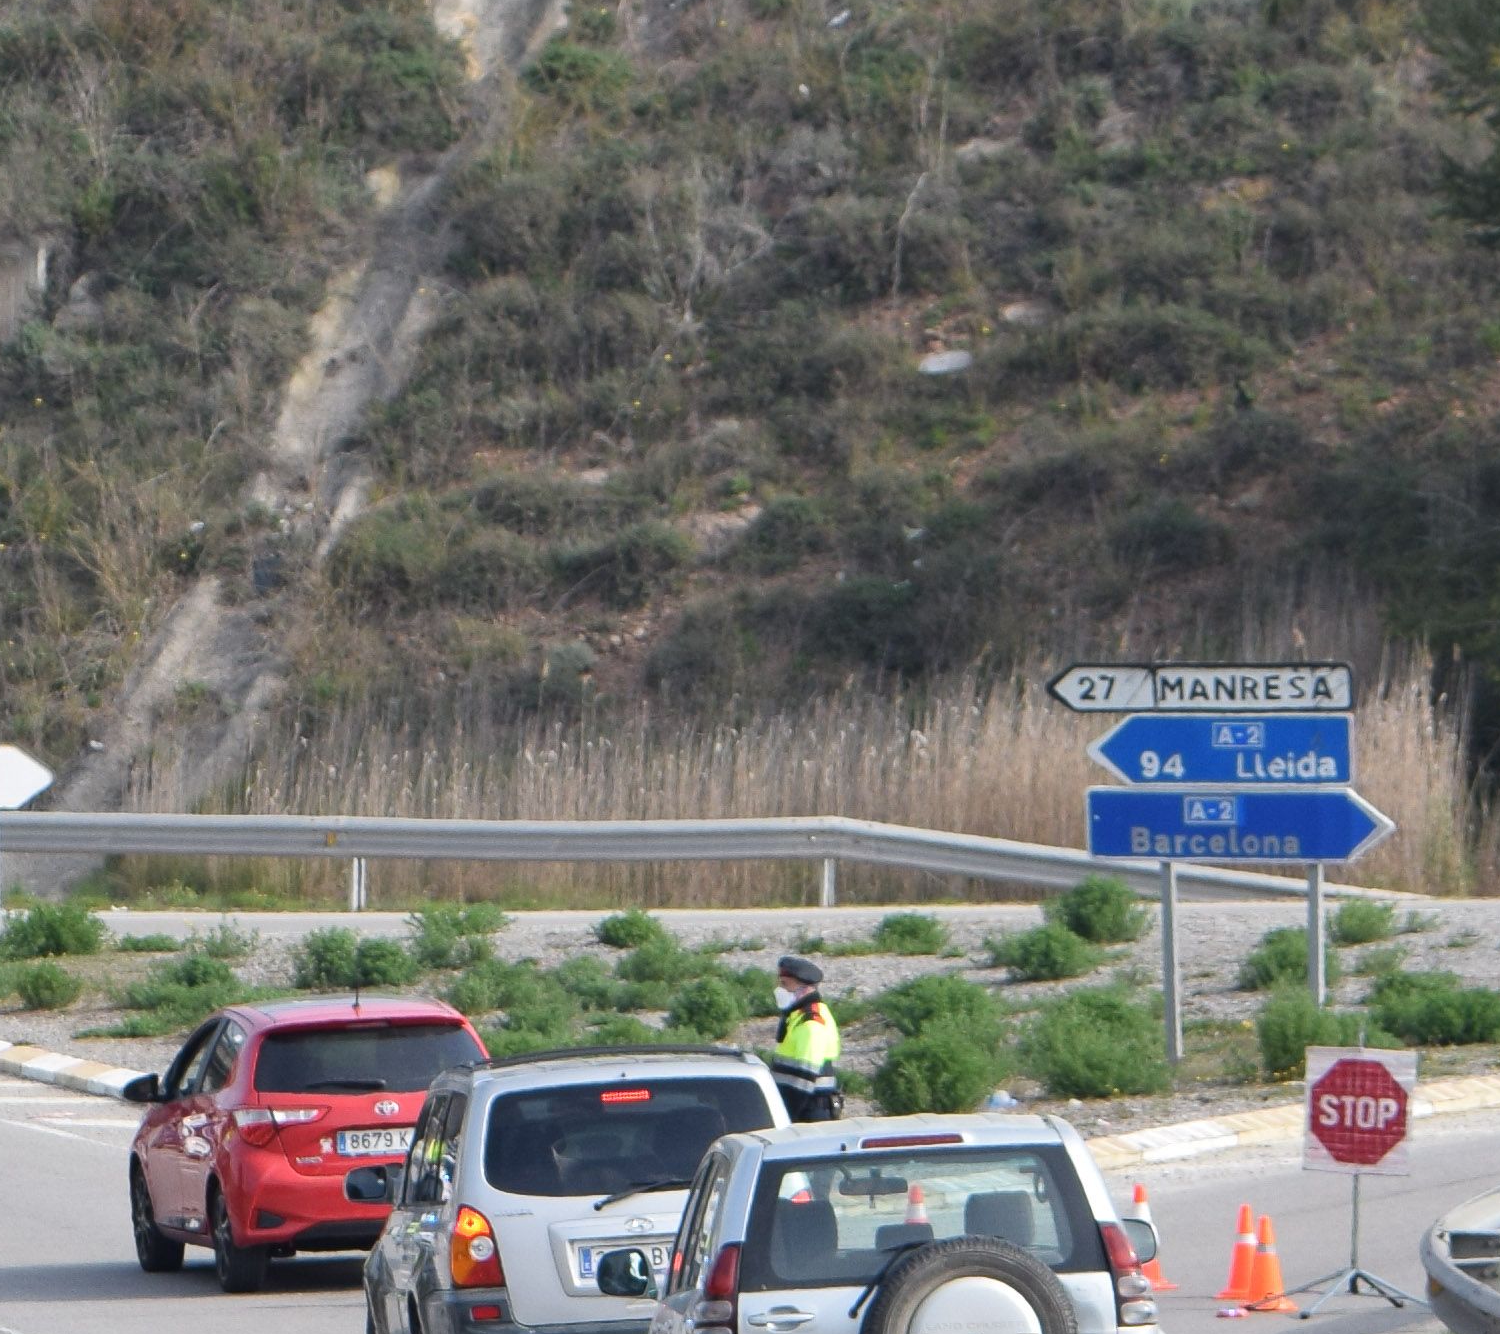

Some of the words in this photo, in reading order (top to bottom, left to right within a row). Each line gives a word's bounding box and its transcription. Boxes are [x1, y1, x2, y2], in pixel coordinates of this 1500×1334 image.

[1079, 675, 1116, 700] 27
[1160, 675, 1334, 701] MANRESA
[1217, 724, 1260, 745] A-2
[1140, 753, 1184, 779] 94
[1236, 750, 1337, 780] Lleida
[1190, 799, 1235, 821] A-2
[1130, 825, 1300, 856] Barcelona
[1318, 1093, 1400, 1130] STOP
[351, 1131, 394, 1150] 8679
